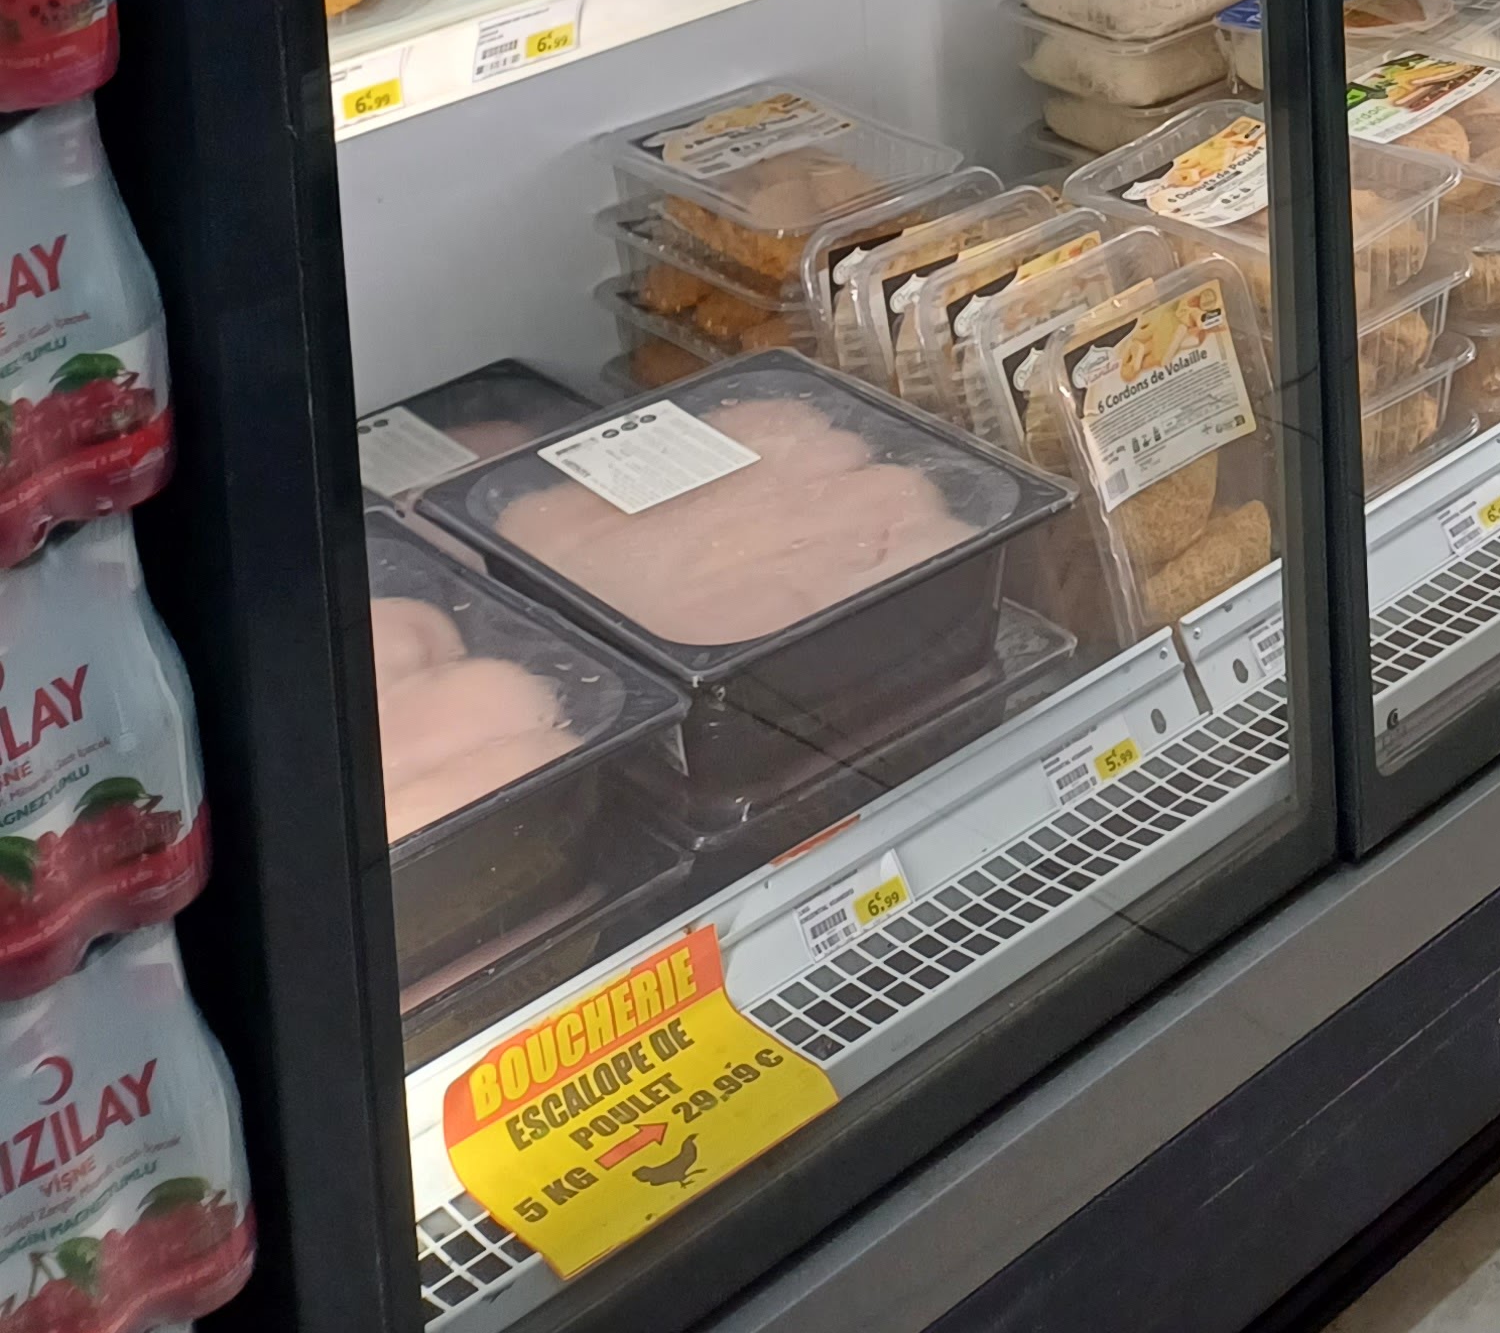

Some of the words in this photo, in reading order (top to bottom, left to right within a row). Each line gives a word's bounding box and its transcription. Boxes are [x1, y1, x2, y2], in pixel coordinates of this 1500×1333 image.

[1175, 175, 1219, 202] Donuts
[1217, 166, 1231, 182] de
[1229, 145, 1265, 175] Poulet
[1096, 399, 1105, 415] 6
[1104, 379, 1150, 412] Cordons
[1149, 368, 1166, 386] de
[1165, 347, 1209, 378] Volaille
[468, 946, 698, 1122] BOUCHERIE
[505, 1043, 656, 1153] ESCALOPE
[648, 1017, 696, 1062] DE
[512, 1197, 549, 1224] 5
[551, 1166, 600, 1205] KG
[672, 1060, 763, 1126] 29,99
[756, 1047, 784, 1070] €
[568, 1072, 684, 1152] POULET
